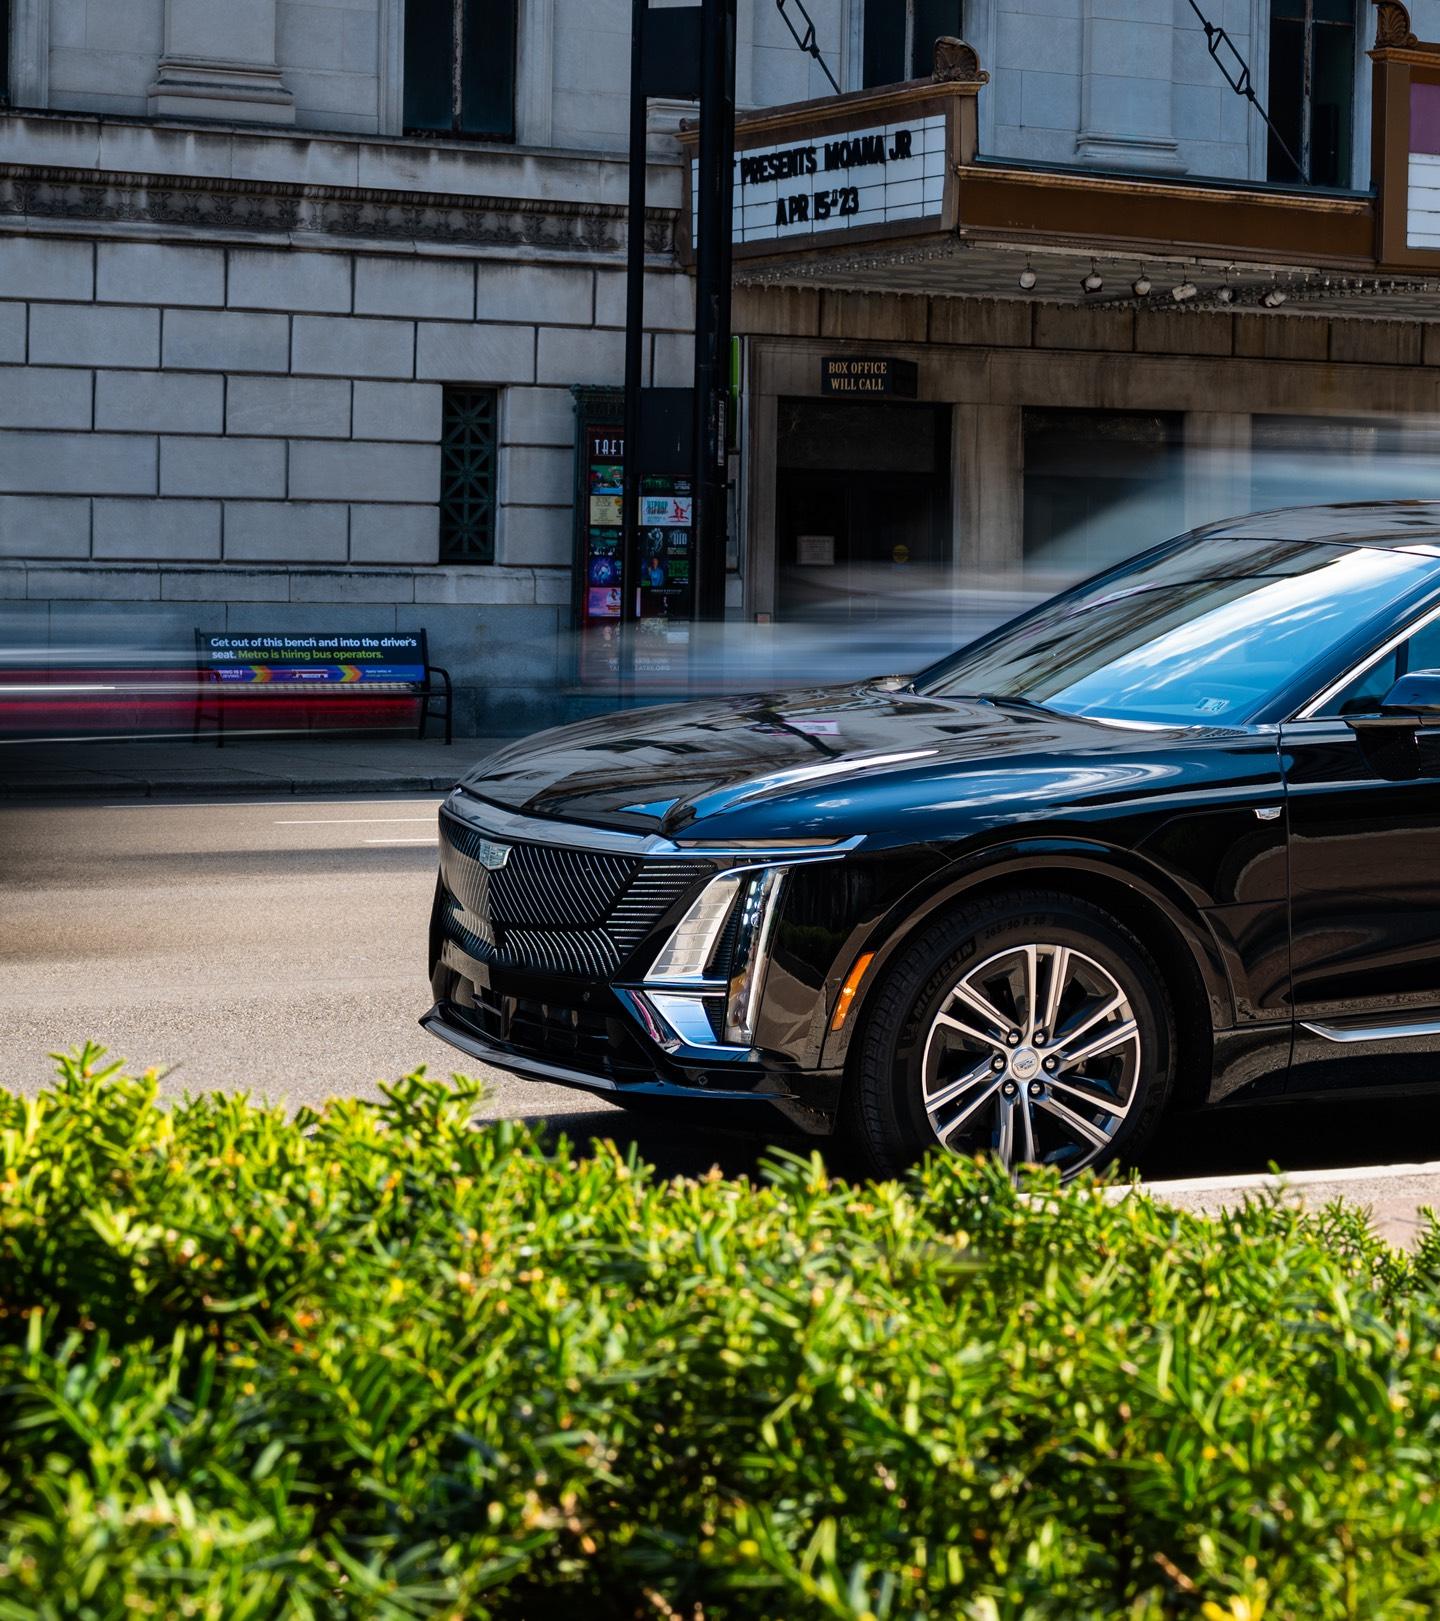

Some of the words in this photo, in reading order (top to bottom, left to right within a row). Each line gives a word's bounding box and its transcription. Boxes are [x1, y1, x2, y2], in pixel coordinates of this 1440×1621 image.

[741, 146, 817, 185] PRESENTS
[824, 135, 885, 171] MOANA
[889, 130, 912, 161] JR
[776, 194, 809, 225] APR
[828, 362, 848, 374] BOX
[850, 362, 887, 374] OFFICE
[831, 378, 857, 390] WILL
[859, 378, 884, 390] CALL
[594, 439, 625, 455] TAFT
[211, 638, 231, 647] Get
[231, 638, 249, 647] out
[251, 638, 262, 647] of
[263, 638, 283, 647] this
[284, 637, 317, 647] bench
[318, 638, 338, 647] and
[340, 638, 360, 647] into
[361, 638, 379, 647] the
[381, 637, 417, 647] driver's
[212, 650, 237, 659] seat.
[238, 650, 269, 659] Metro
[270, 649, 280, 659] is
[281, 649, 311, 660] hiring
[312, 650, 332, 659] bus
[333, 650, 384, 660] operators.
[913, 940, 975, 1019] MICHELIN
